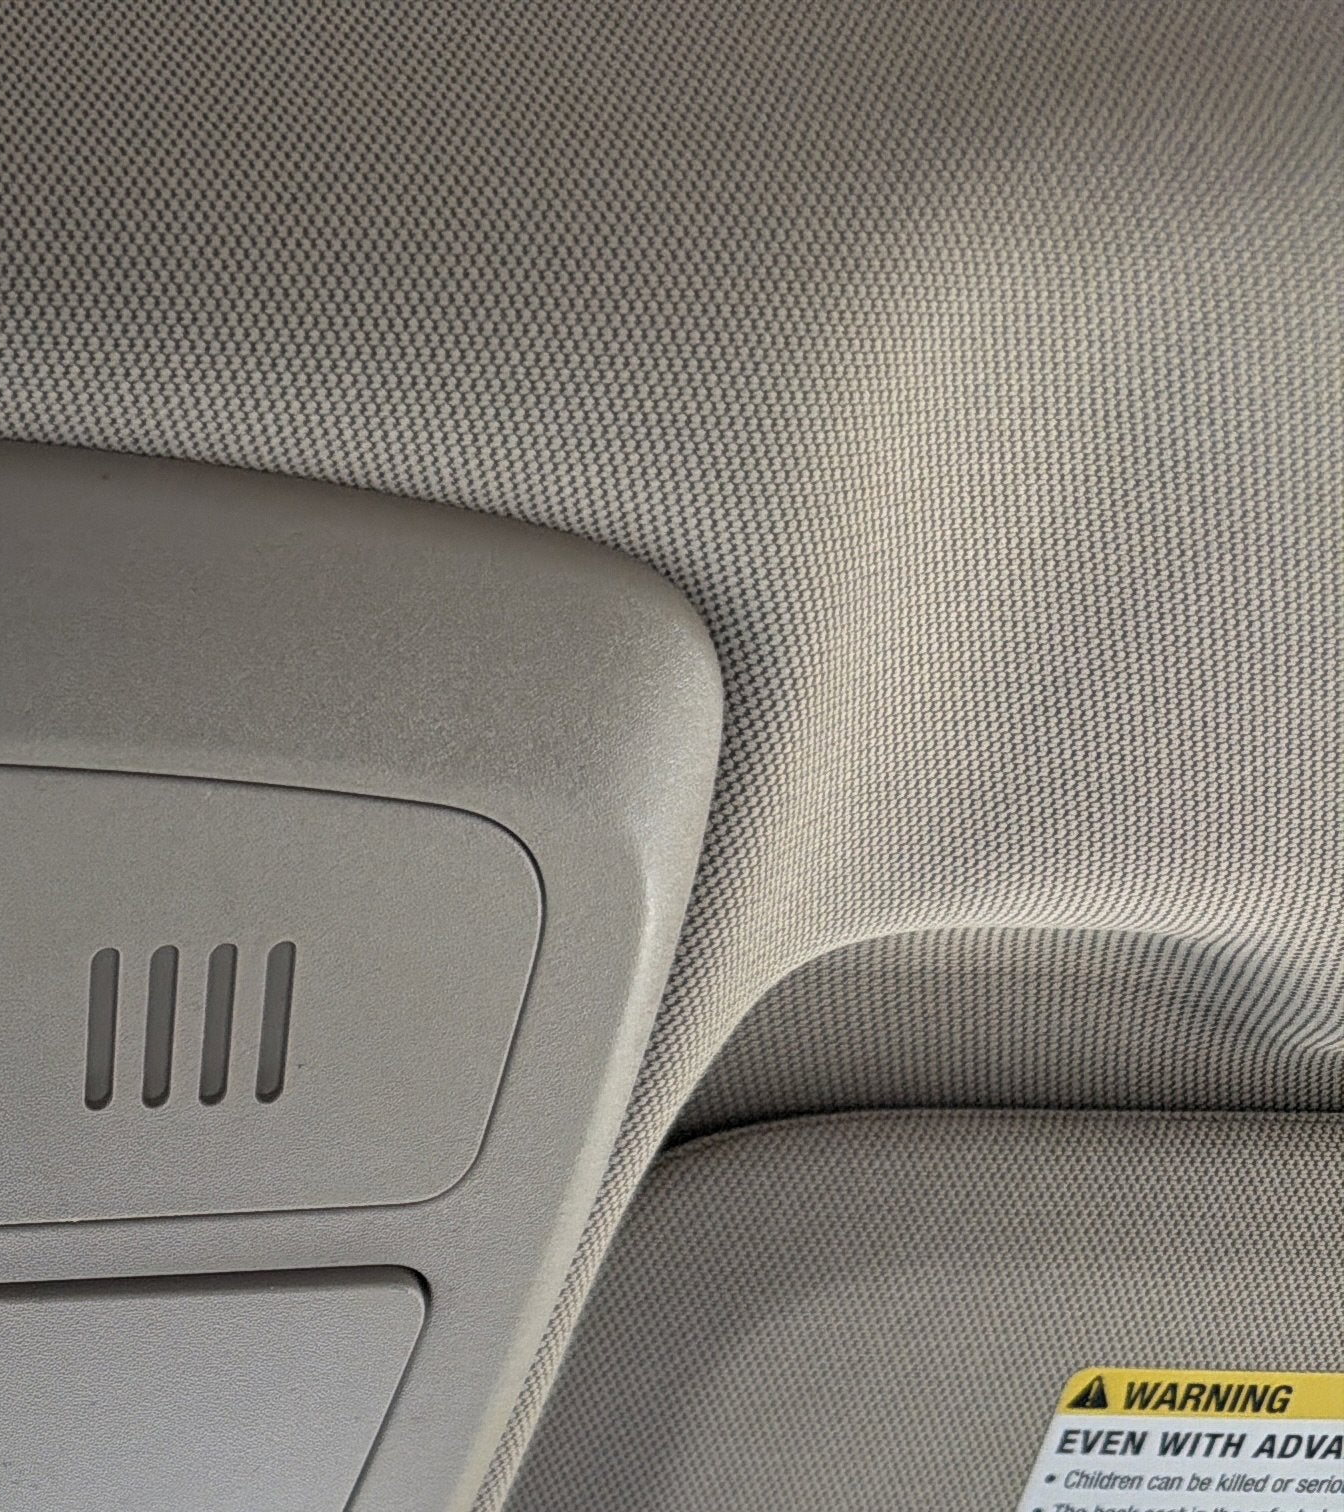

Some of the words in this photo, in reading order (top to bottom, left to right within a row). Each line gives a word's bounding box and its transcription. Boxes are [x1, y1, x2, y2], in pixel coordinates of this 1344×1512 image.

[1123, 1382, 1293, 1413] WARNING
[1056, 1429, 1148, 1455] EVEN
[1157, 1431, 1247, 1458] WITH
[1251, 1434, 1344, 1459] ADVA
[1064, 1469, 1143, 1490] Children
[1147, 1475, 1183, 1491] can
[1186, 1473, 1212, 1491] be
[1215, 1474, 1270, 1492] killed
[1271, 1478, 1293, 1492] or
